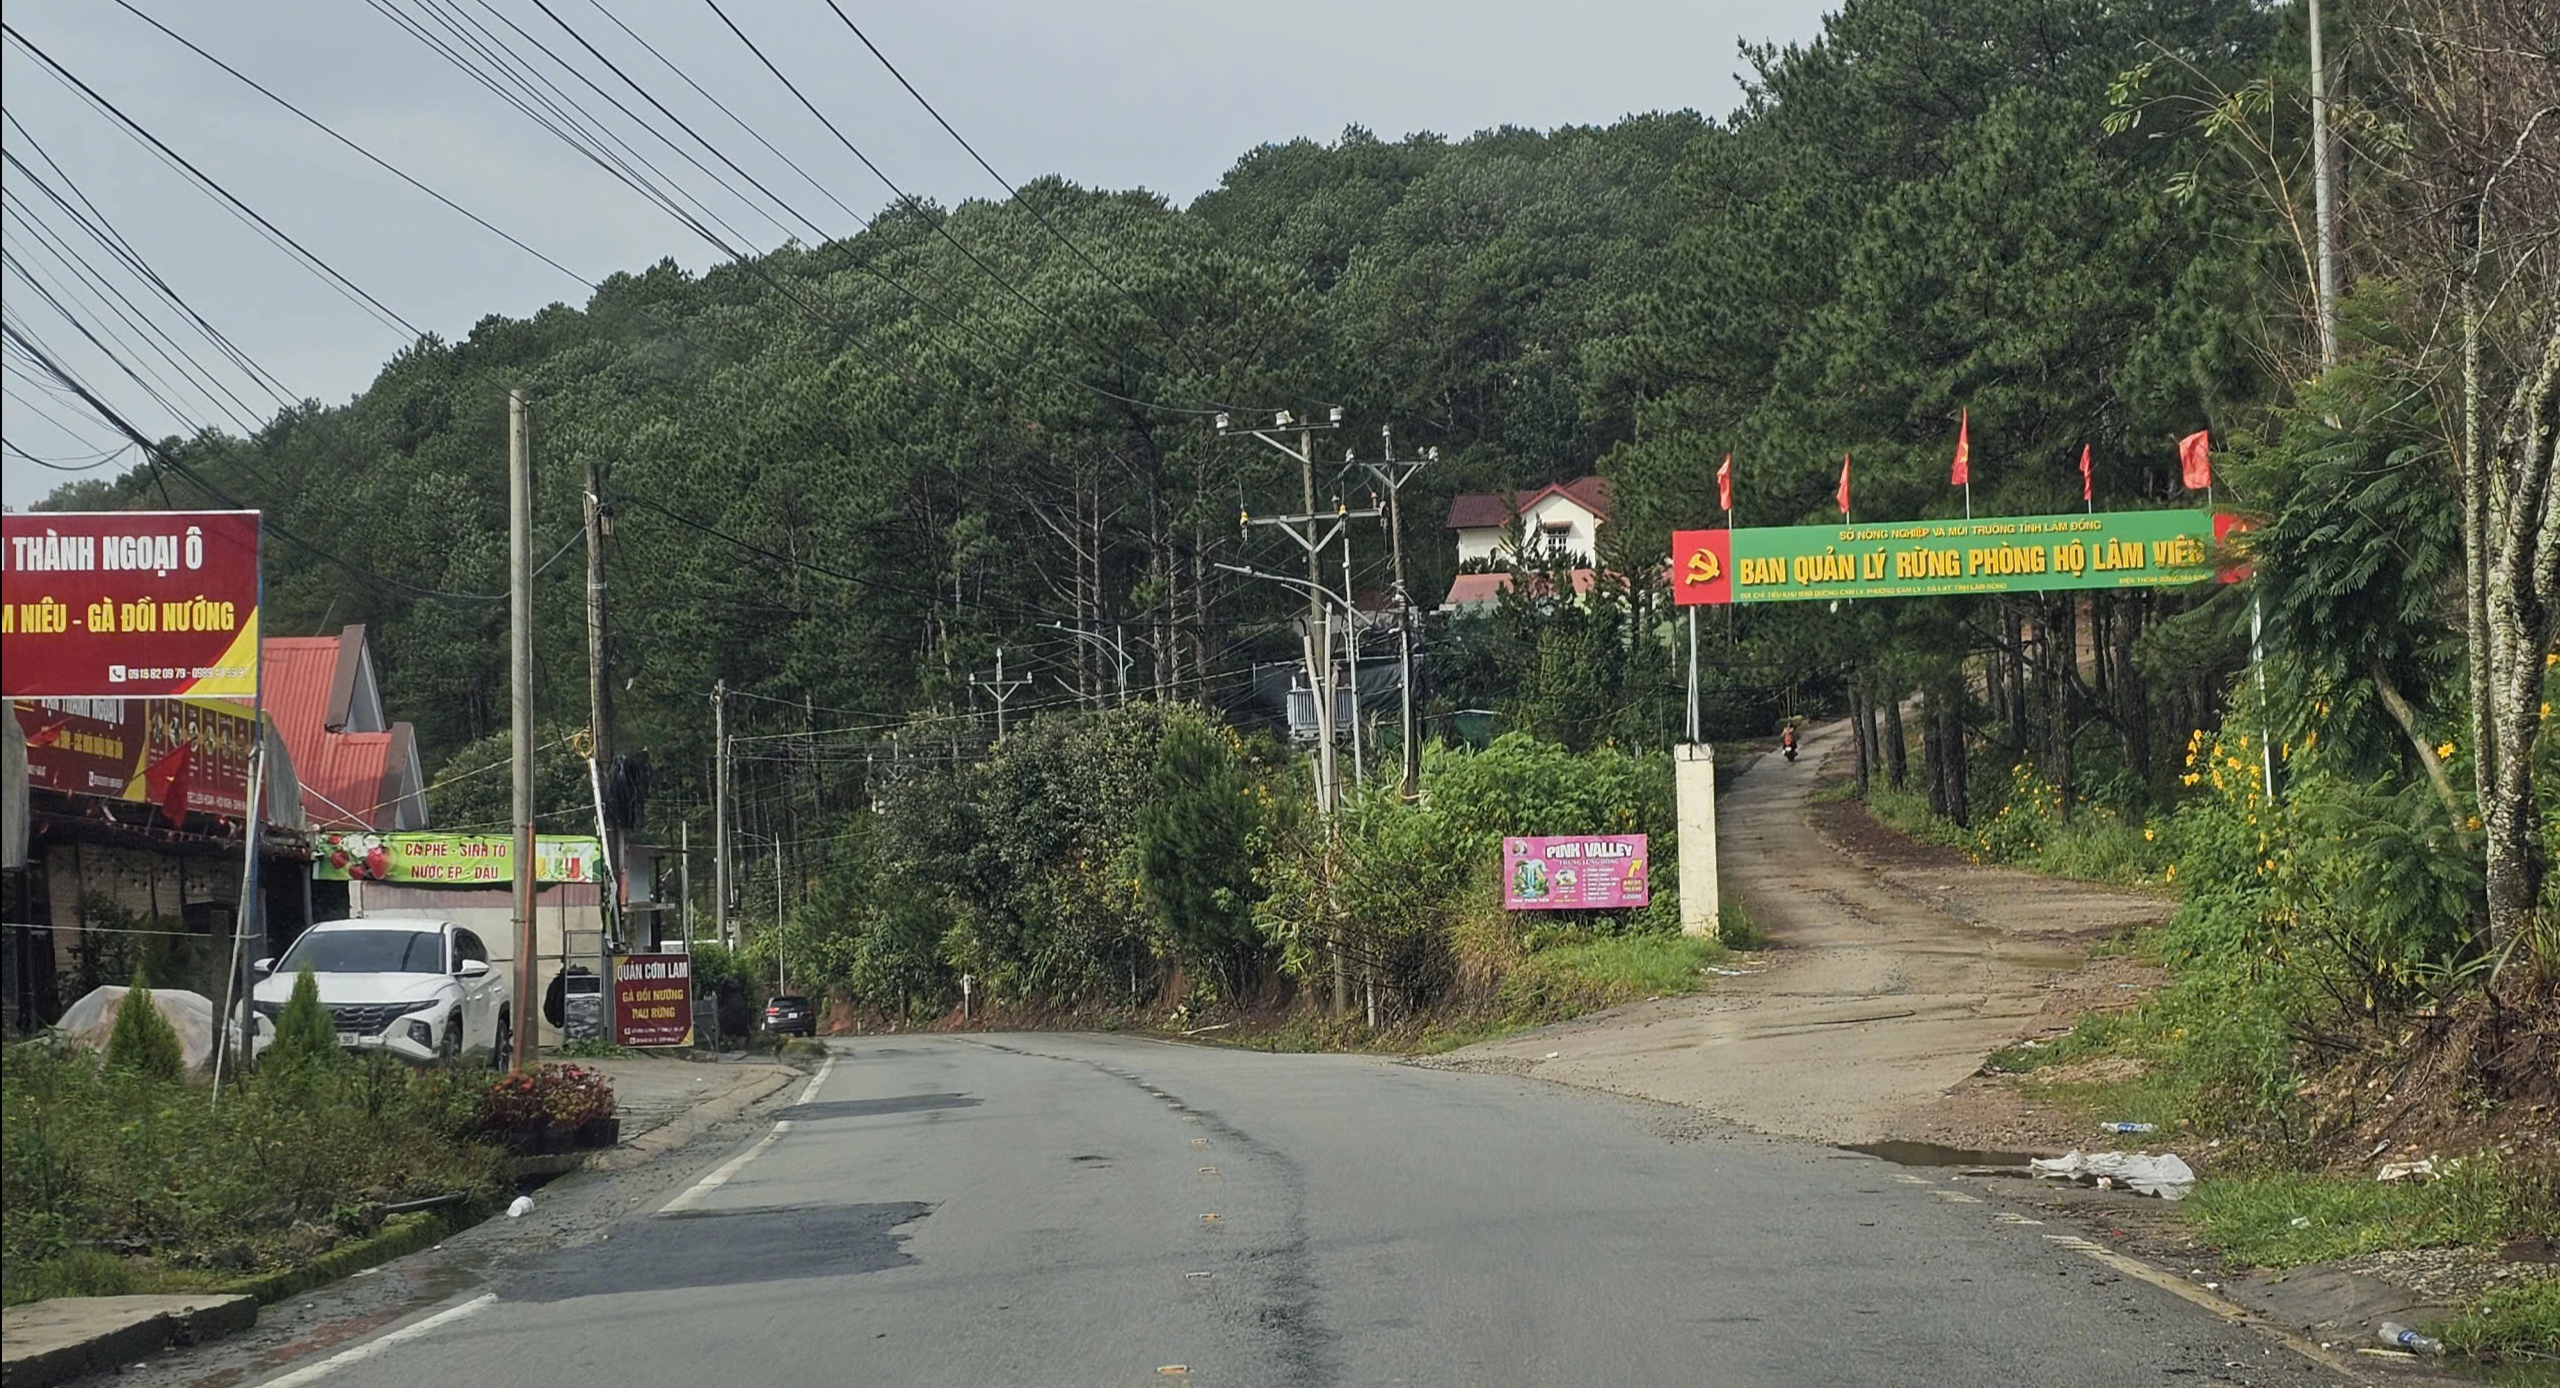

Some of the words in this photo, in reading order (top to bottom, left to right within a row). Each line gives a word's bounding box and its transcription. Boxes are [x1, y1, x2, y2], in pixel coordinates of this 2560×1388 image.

[1857, 527, 1889, 540] NÔNG
[1892, 527, 1930, 541] NGHIỆP
[1971, 523, 2016, 535] TRƯỜNG
[2043, 520, 2068, 532] LÂM
[2070, 518, 2102, 531] ĐỒNG
[12, 528, 94, 571] THÀNH
[102, 535, 178, 577] NGOẠI
[185, 526, 203, 570] Ô
[1740, 557, 1787, 586] BAN
[1793, 546, 1856, 586] QUẢN
[1863, 547, 1887, 580] LÝ
[1896, 546, 1961, 579] RỪNG
[1968, 541, 2046, 576] PHÒNG
[2053, 538, 2085, 577] HỘ
[2092, 537, 2145, 571] LÂM
[21, 595, 67, 633] NIÊU
[87, 596, 116, 633] GÀ
[120, 596, 157, 632] ĐỒI
[162, 595, 235, 632] NƯỚNG
[424, 841, 448, 857] PHÊ
[460, 843, 489, 858] SINH
[1546, 842, 1581, 859] PINK
[1583, 841, 1634, 858] VALLEY
[411, 862, 444, 878] NƯỚC
[447, 862, 463, 878] ÉP
[474, 863, 499, 879] DÂU
[617, 961, 643, 982] QUÁN
[644, 961, 666, 979] CƠM
[667, 962, 688, 979] LAM
[622, 988, 635, 1002] GÀ
